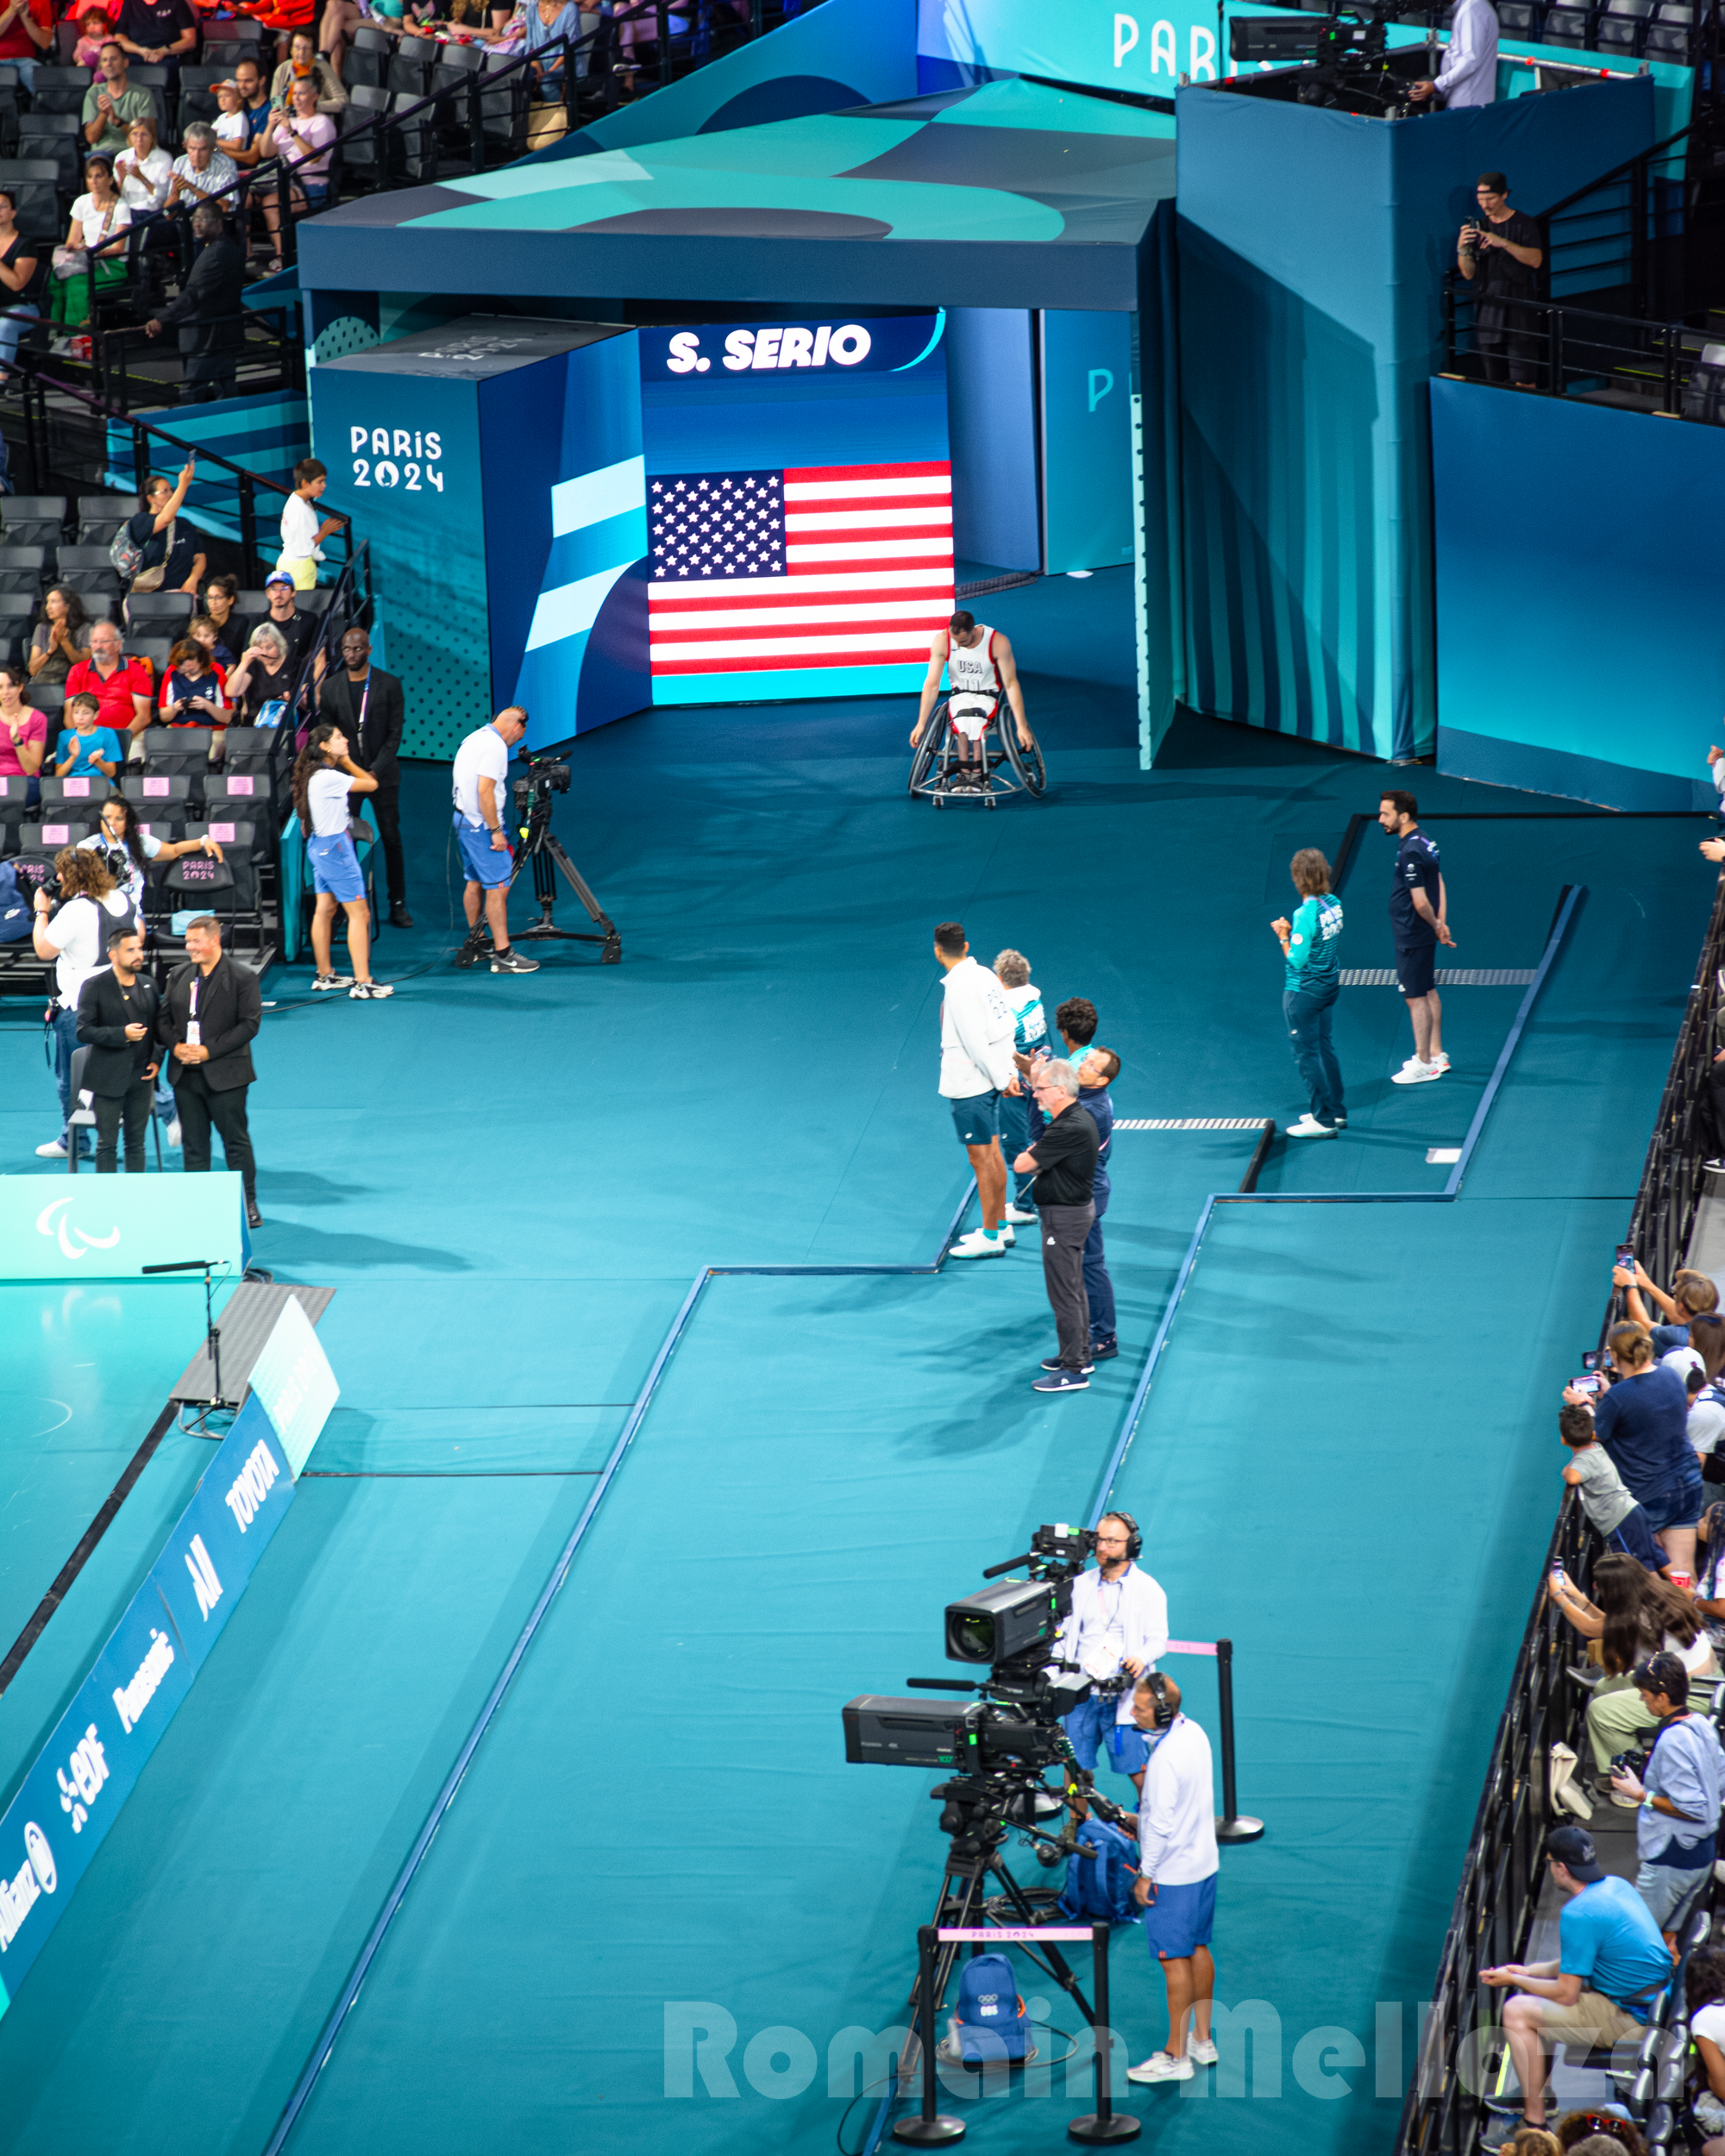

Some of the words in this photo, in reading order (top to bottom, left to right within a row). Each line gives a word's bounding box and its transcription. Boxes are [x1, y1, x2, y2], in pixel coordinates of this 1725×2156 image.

[667, 332, 711, 373] S.
[722, 323, 872, 371] SERIO
[352, 458, 444, 492] 2024
[957, 660, 983, 674] USA
[182, 870, 215, 881] 2024
[224, 1438, 280, 1534] TOYOTA
[112, 1627, 174, 1735] Panasonic
